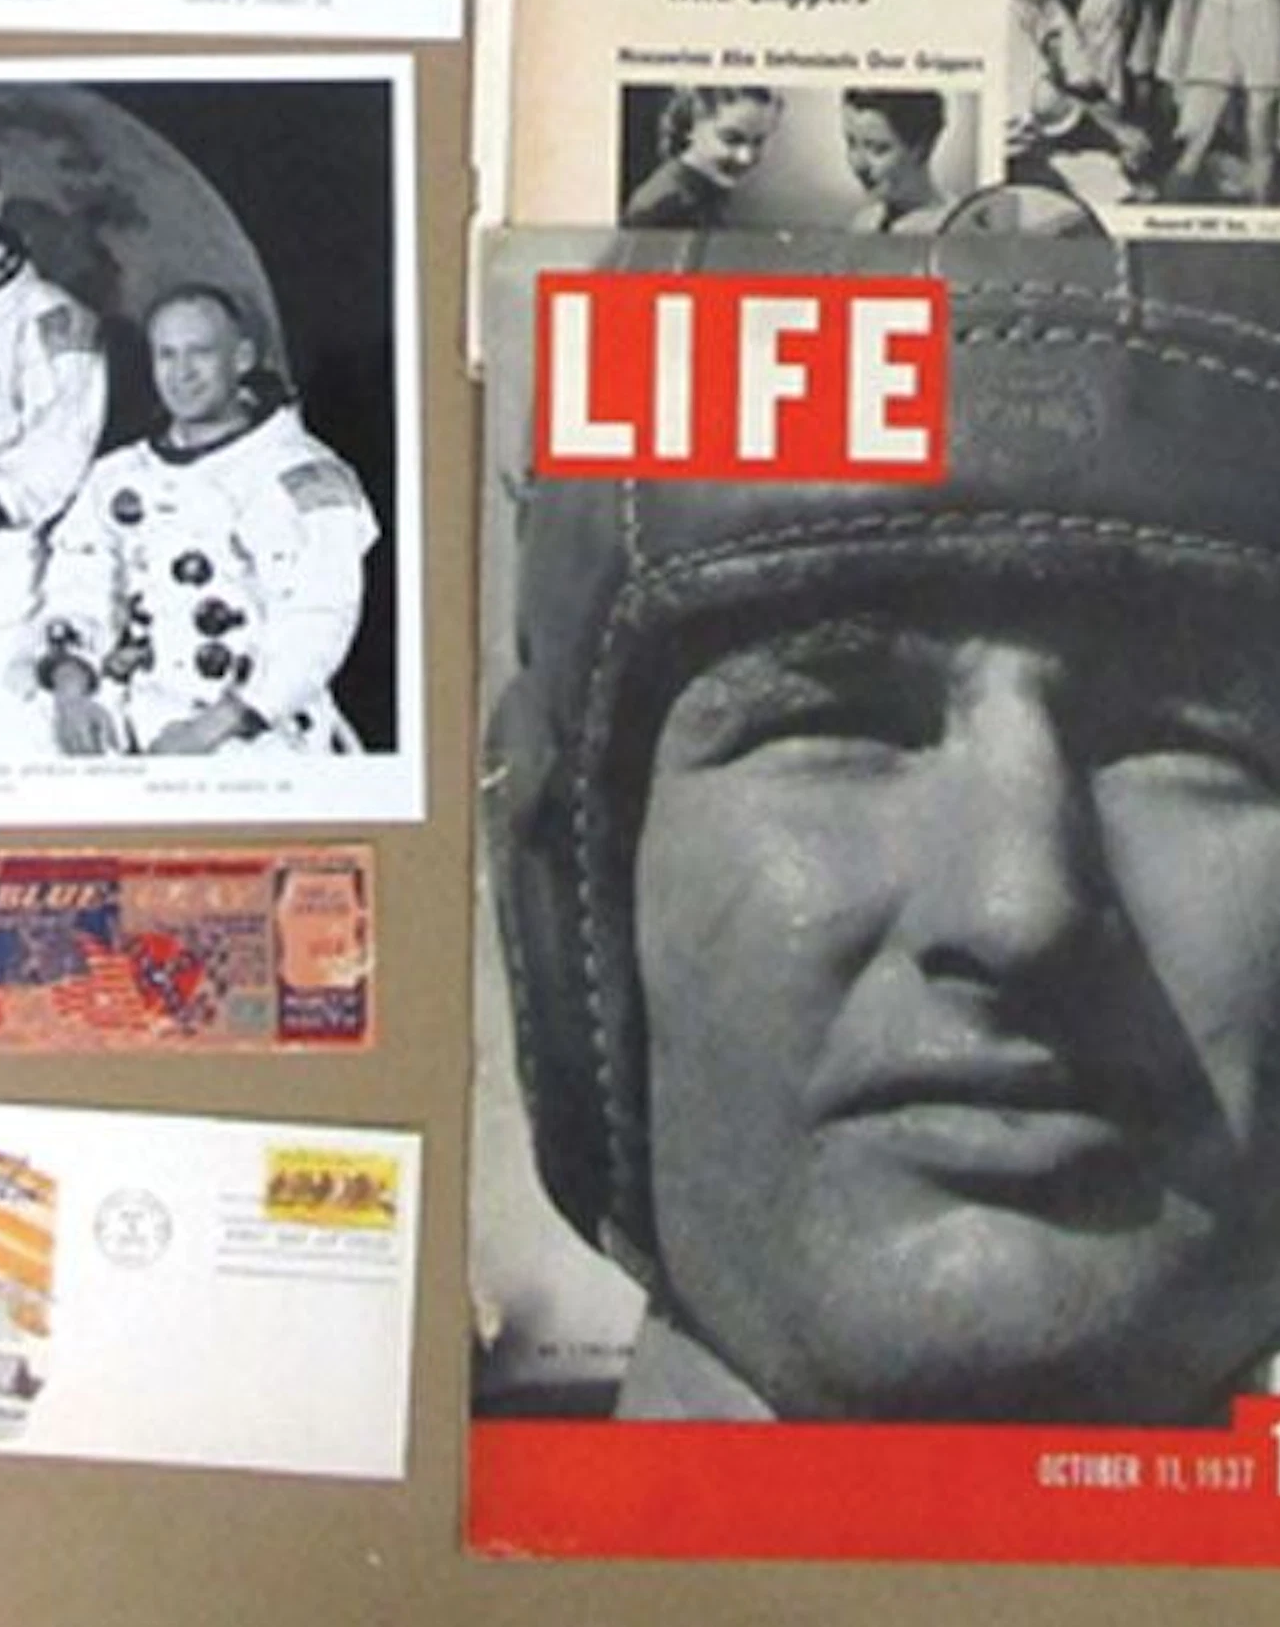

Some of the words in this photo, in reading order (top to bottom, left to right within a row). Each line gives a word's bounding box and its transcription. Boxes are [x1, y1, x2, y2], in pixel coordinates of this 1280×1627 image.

[550, 292, 933, 463] LIFE
[1037, 1453, 1141, 1488] OCTOBER
[1196, 1456, 1255, 1490] 1937
